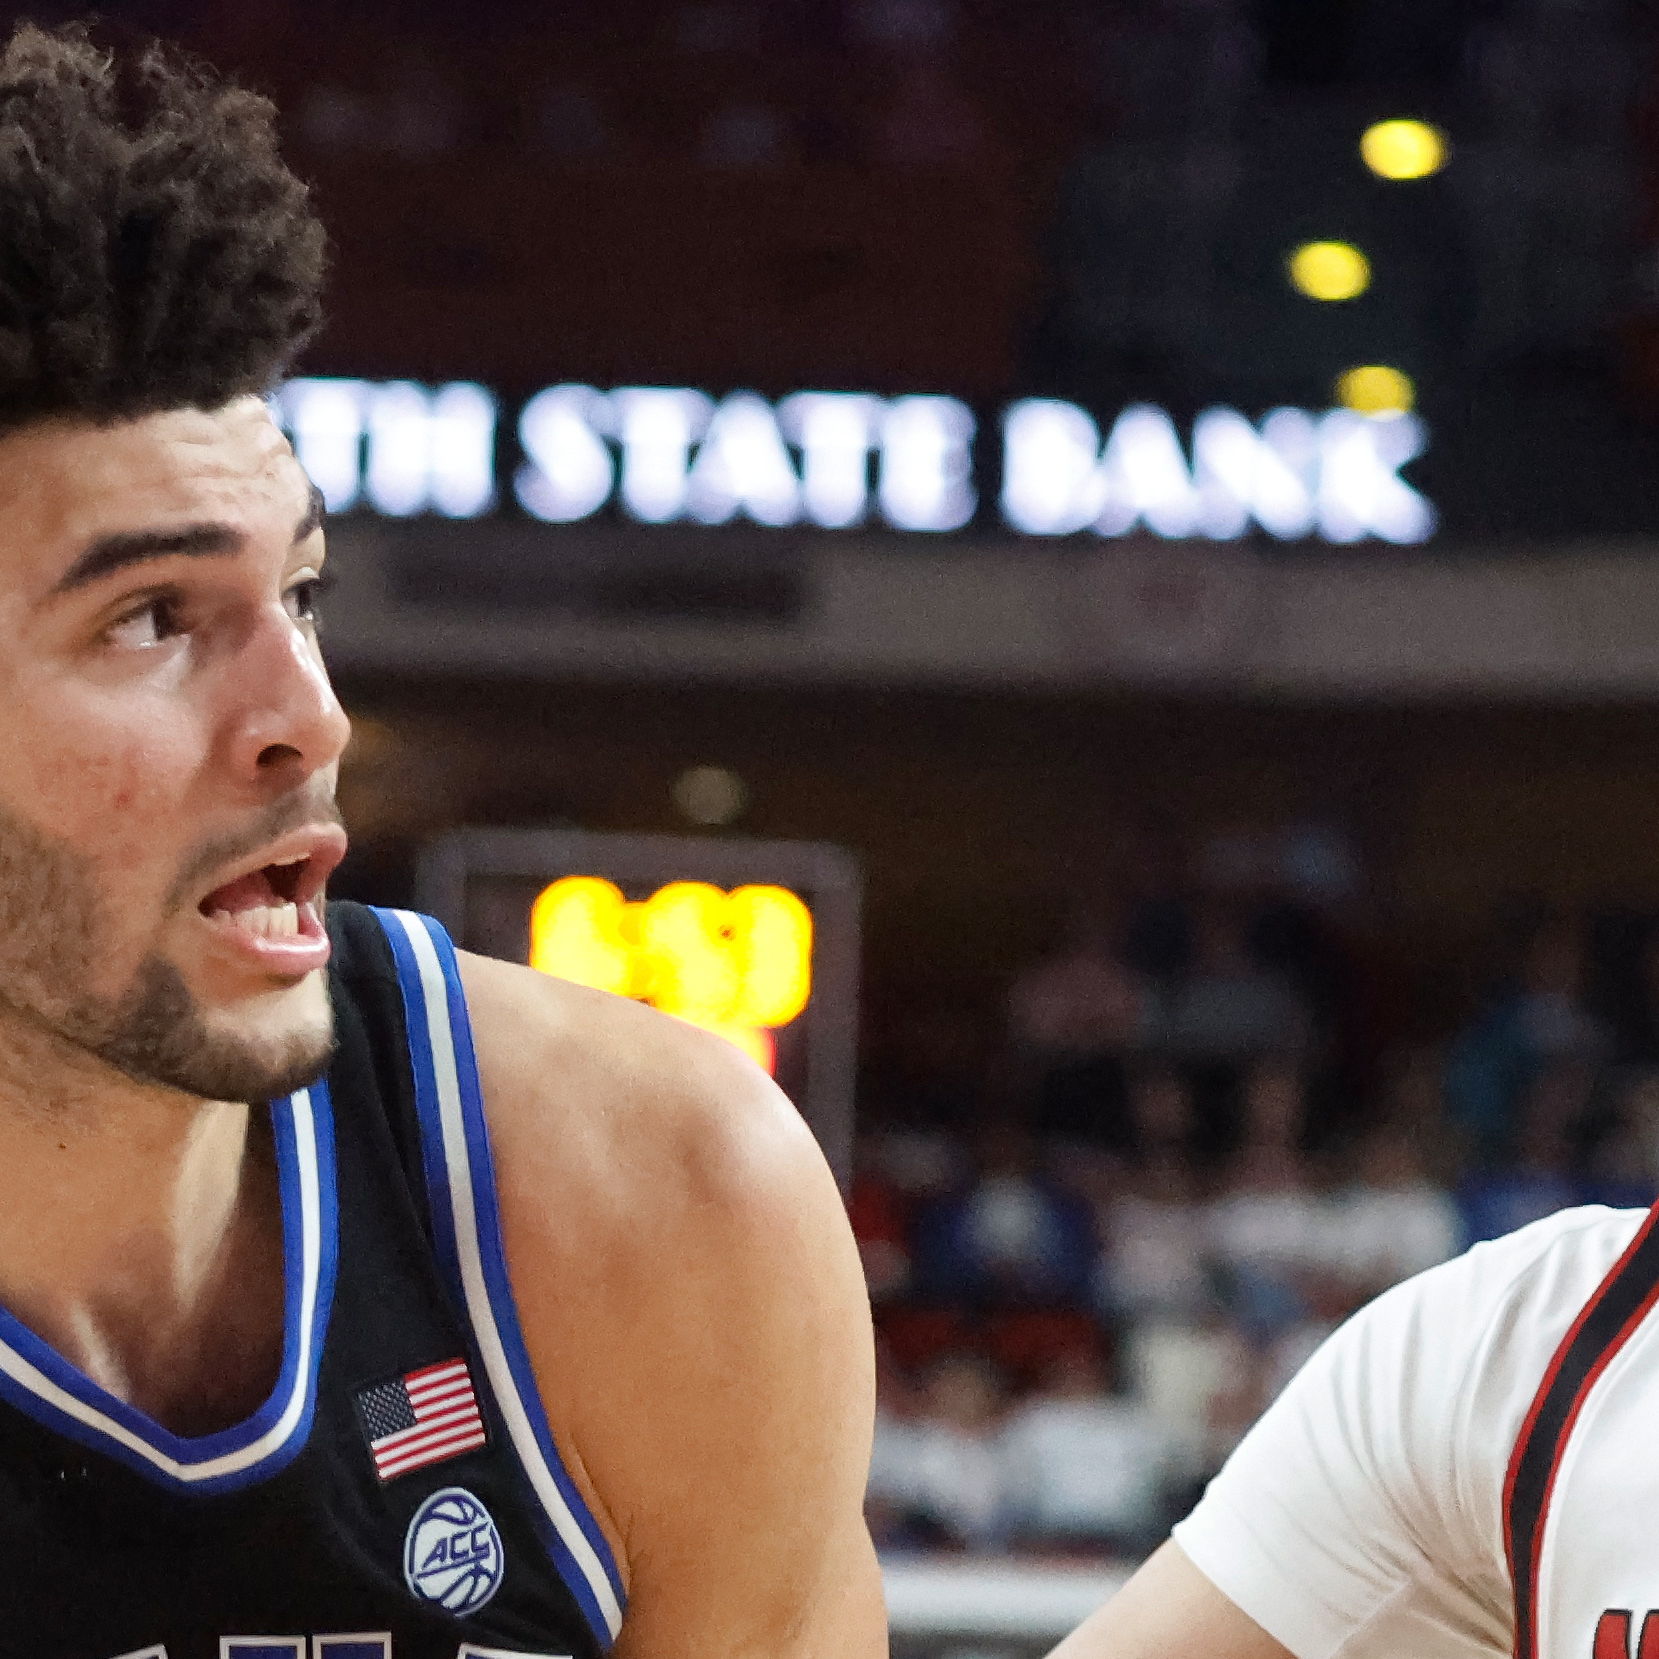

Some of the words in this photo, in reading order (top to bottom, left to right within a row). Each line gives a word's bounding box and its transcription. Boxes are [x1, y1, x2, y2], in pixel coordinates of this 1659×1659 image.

[517, 380, 977, 532] STATE
[1001, 396, 1437, 544] BANK
[422, 1522, 491, 1568] ACC
